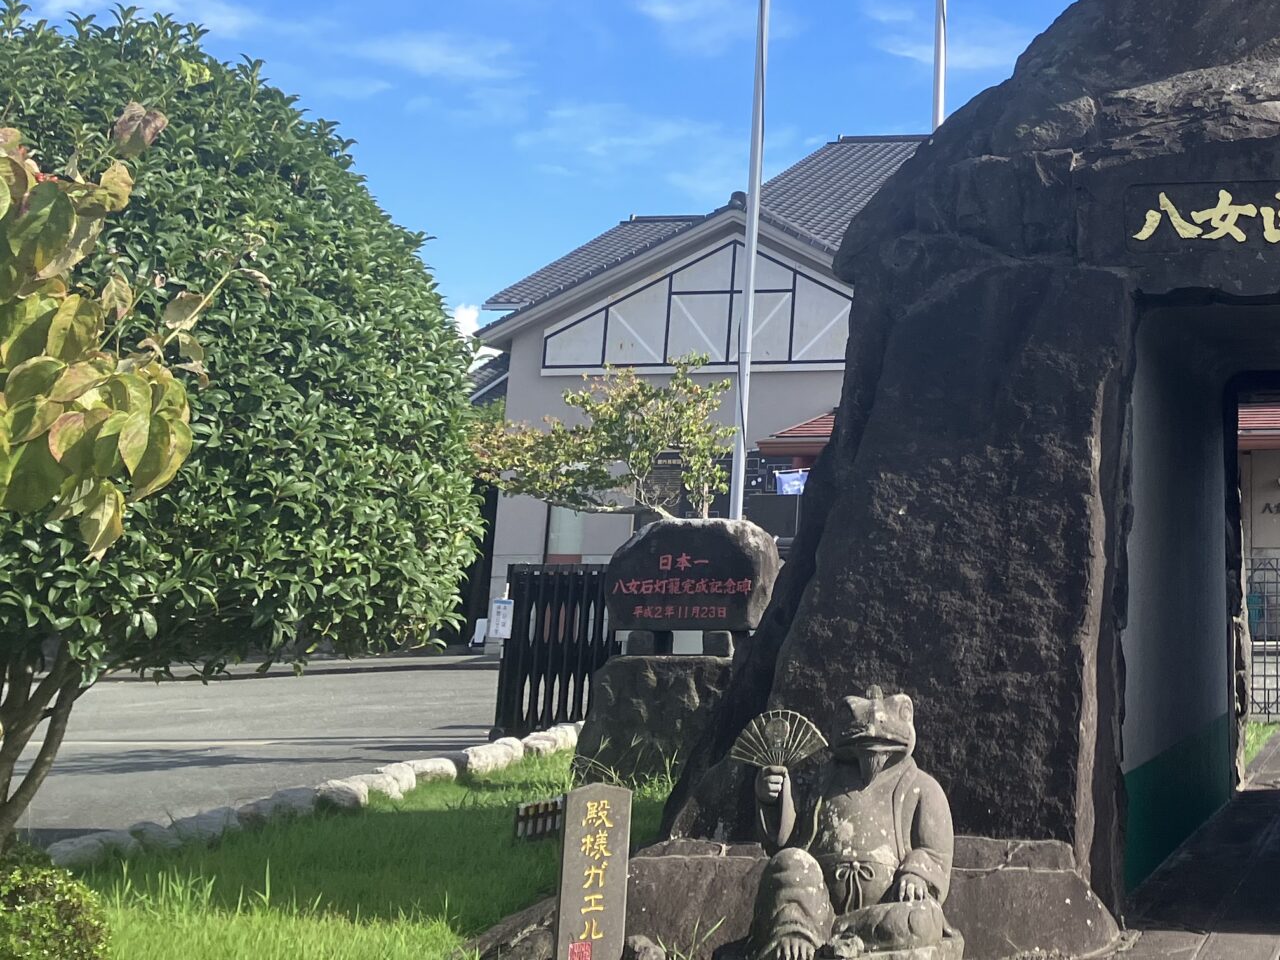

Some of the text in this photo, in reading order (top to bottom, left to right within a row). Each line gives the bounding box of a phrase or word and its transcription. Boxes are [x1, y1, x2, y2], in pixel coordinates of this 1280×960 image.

[659, 552, 709, 571] 日本一
[632, 605, 727, 619] 平成2年11月23日
[579, 800, 614, 940] 殿様ガエル
